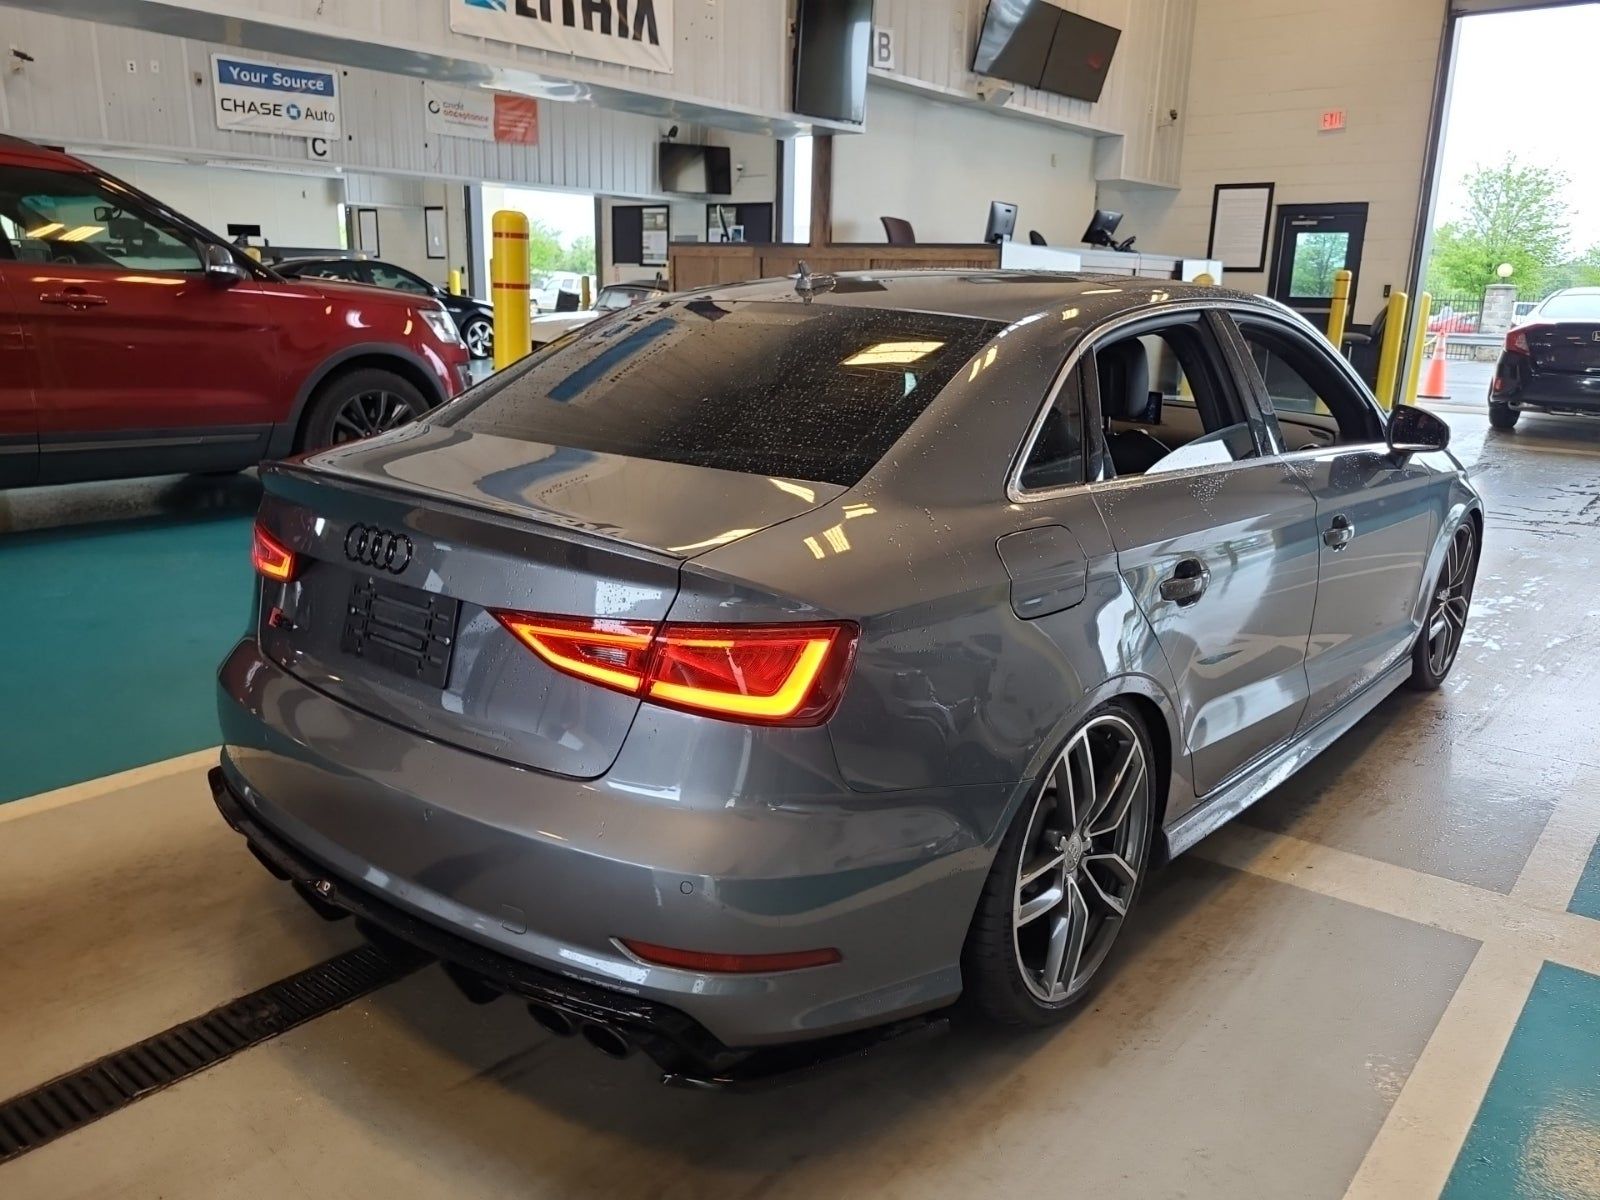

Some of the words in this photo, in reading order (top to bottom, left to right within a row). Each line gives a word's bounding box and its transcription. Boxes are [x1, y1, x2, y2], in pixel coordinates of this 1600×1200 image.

[878, 31, 891, 62] B
[229, 66, 268, 84] Your
[272, 72, 324, 91] Source
[220, 97, 283, 117] CHASE
[304, 107, 335, 123] Auto
[1322, 111, 1344, 128] EXIT
[312, 137, 328, 157] C
